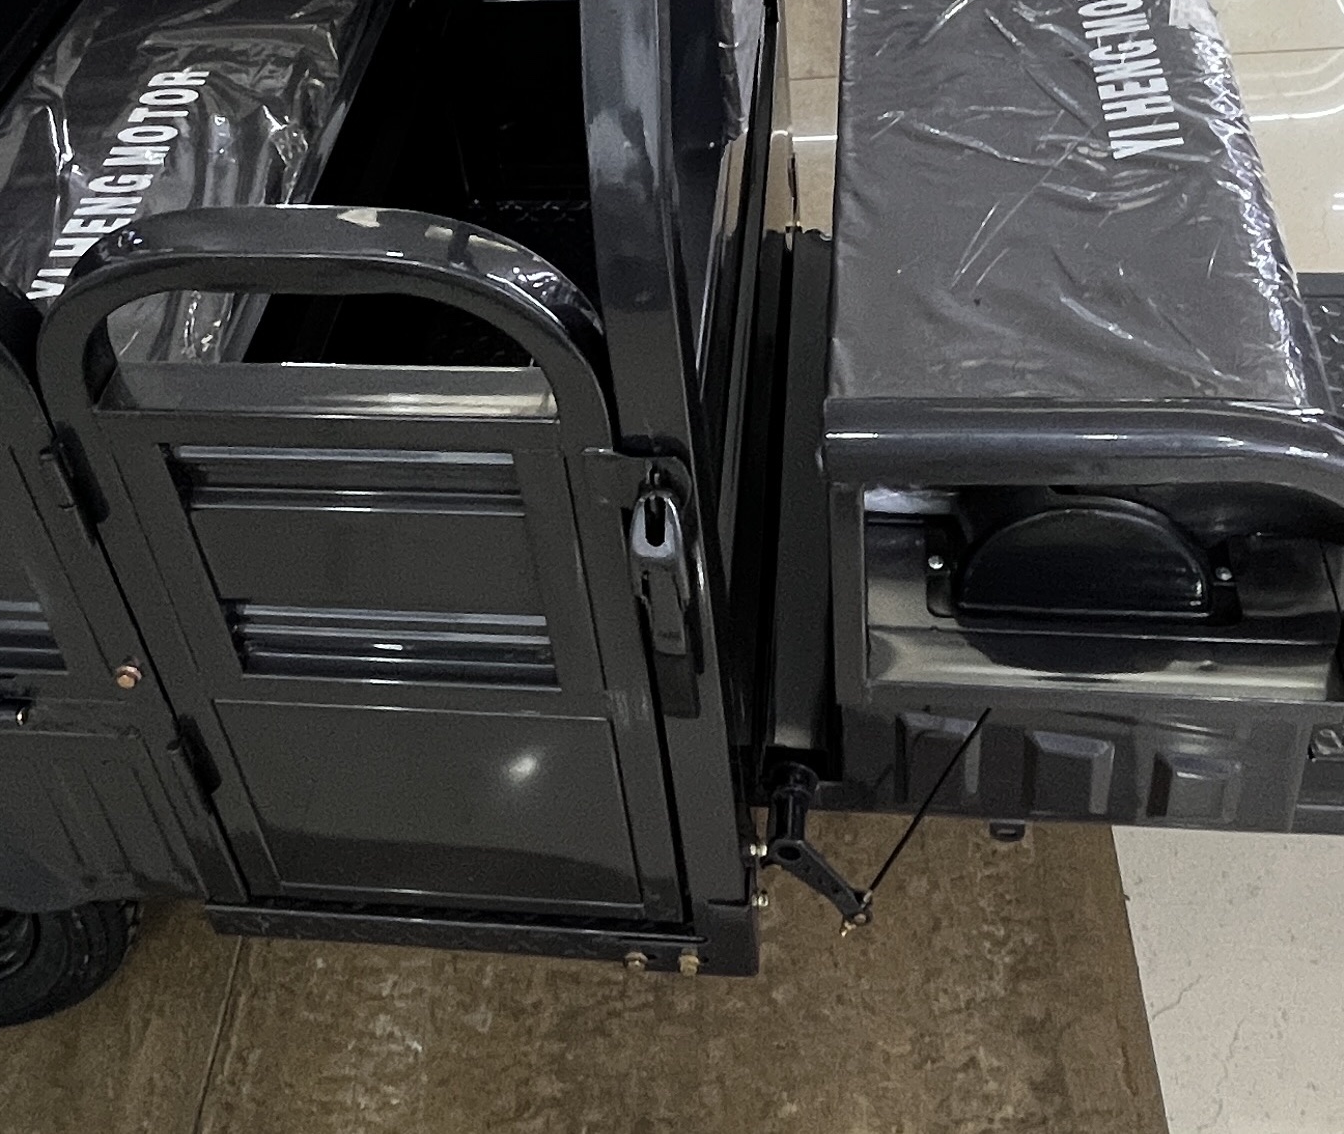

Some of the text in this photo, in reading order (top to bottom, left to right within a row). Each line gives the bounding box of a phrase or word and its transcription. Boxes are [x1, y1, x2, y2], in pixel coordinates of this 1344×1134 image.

[103, 66, 210, 166] MOTOR
[1088, 38, 1175, 121] HENG
[1108, 121, 1185, 160] YI
